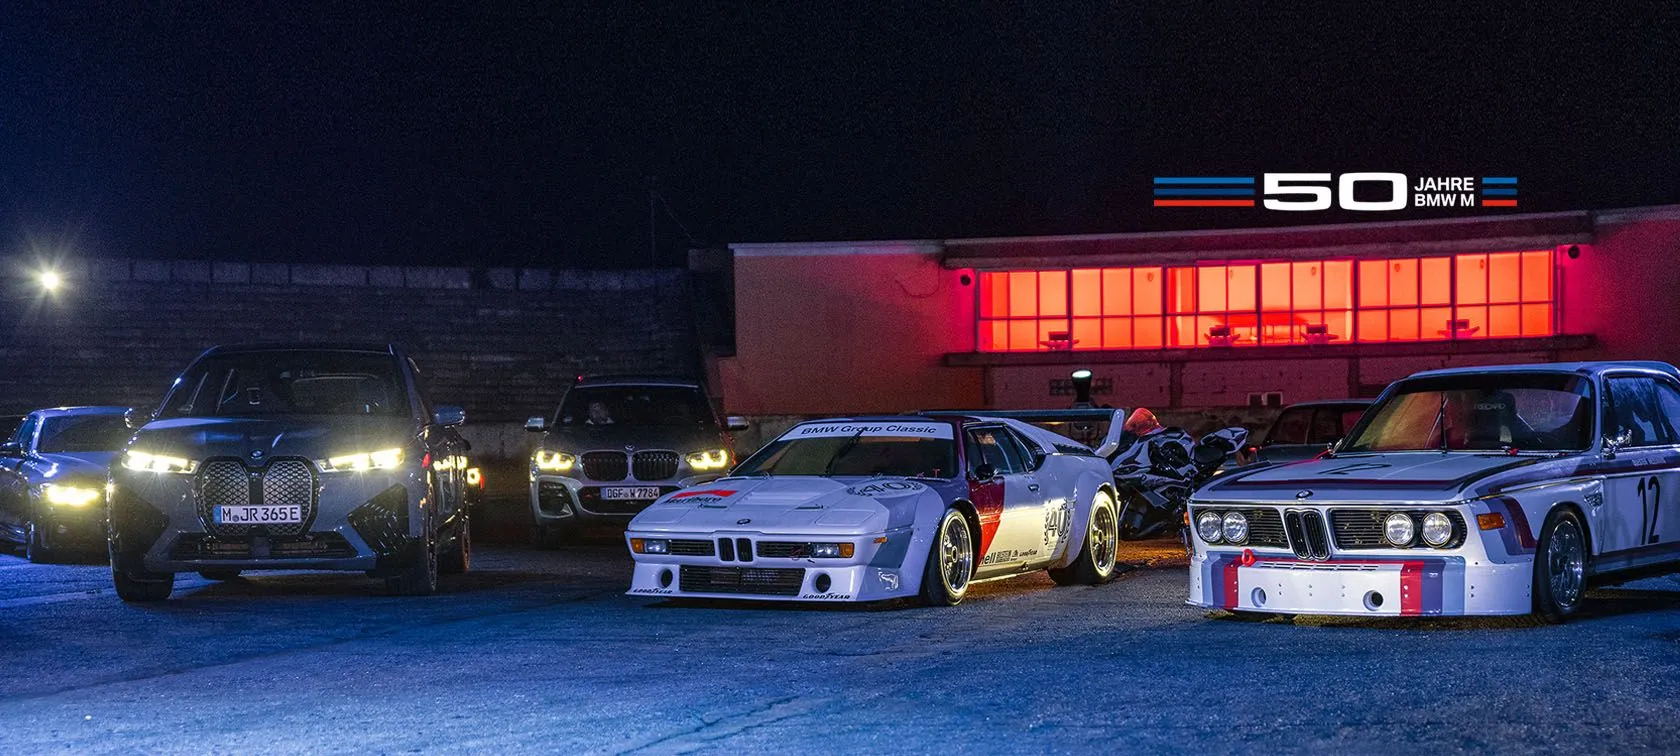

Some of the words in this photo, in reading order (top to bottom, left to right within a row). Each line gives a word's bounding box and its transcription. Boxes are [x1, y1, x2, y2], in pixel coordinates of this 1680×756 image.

[801, 426, 839, 435] BMW
[841, 425, 882, 433] Group
[886, 425, 937, 434] Classic
[607, 488, 624, 498] DGF
[638, 488, 658, 498] 7784
[222, 507, 232, 521] M
[1637, 475, 1660, 545] 12
[803, 592, 851, 600] GOODYEAR
